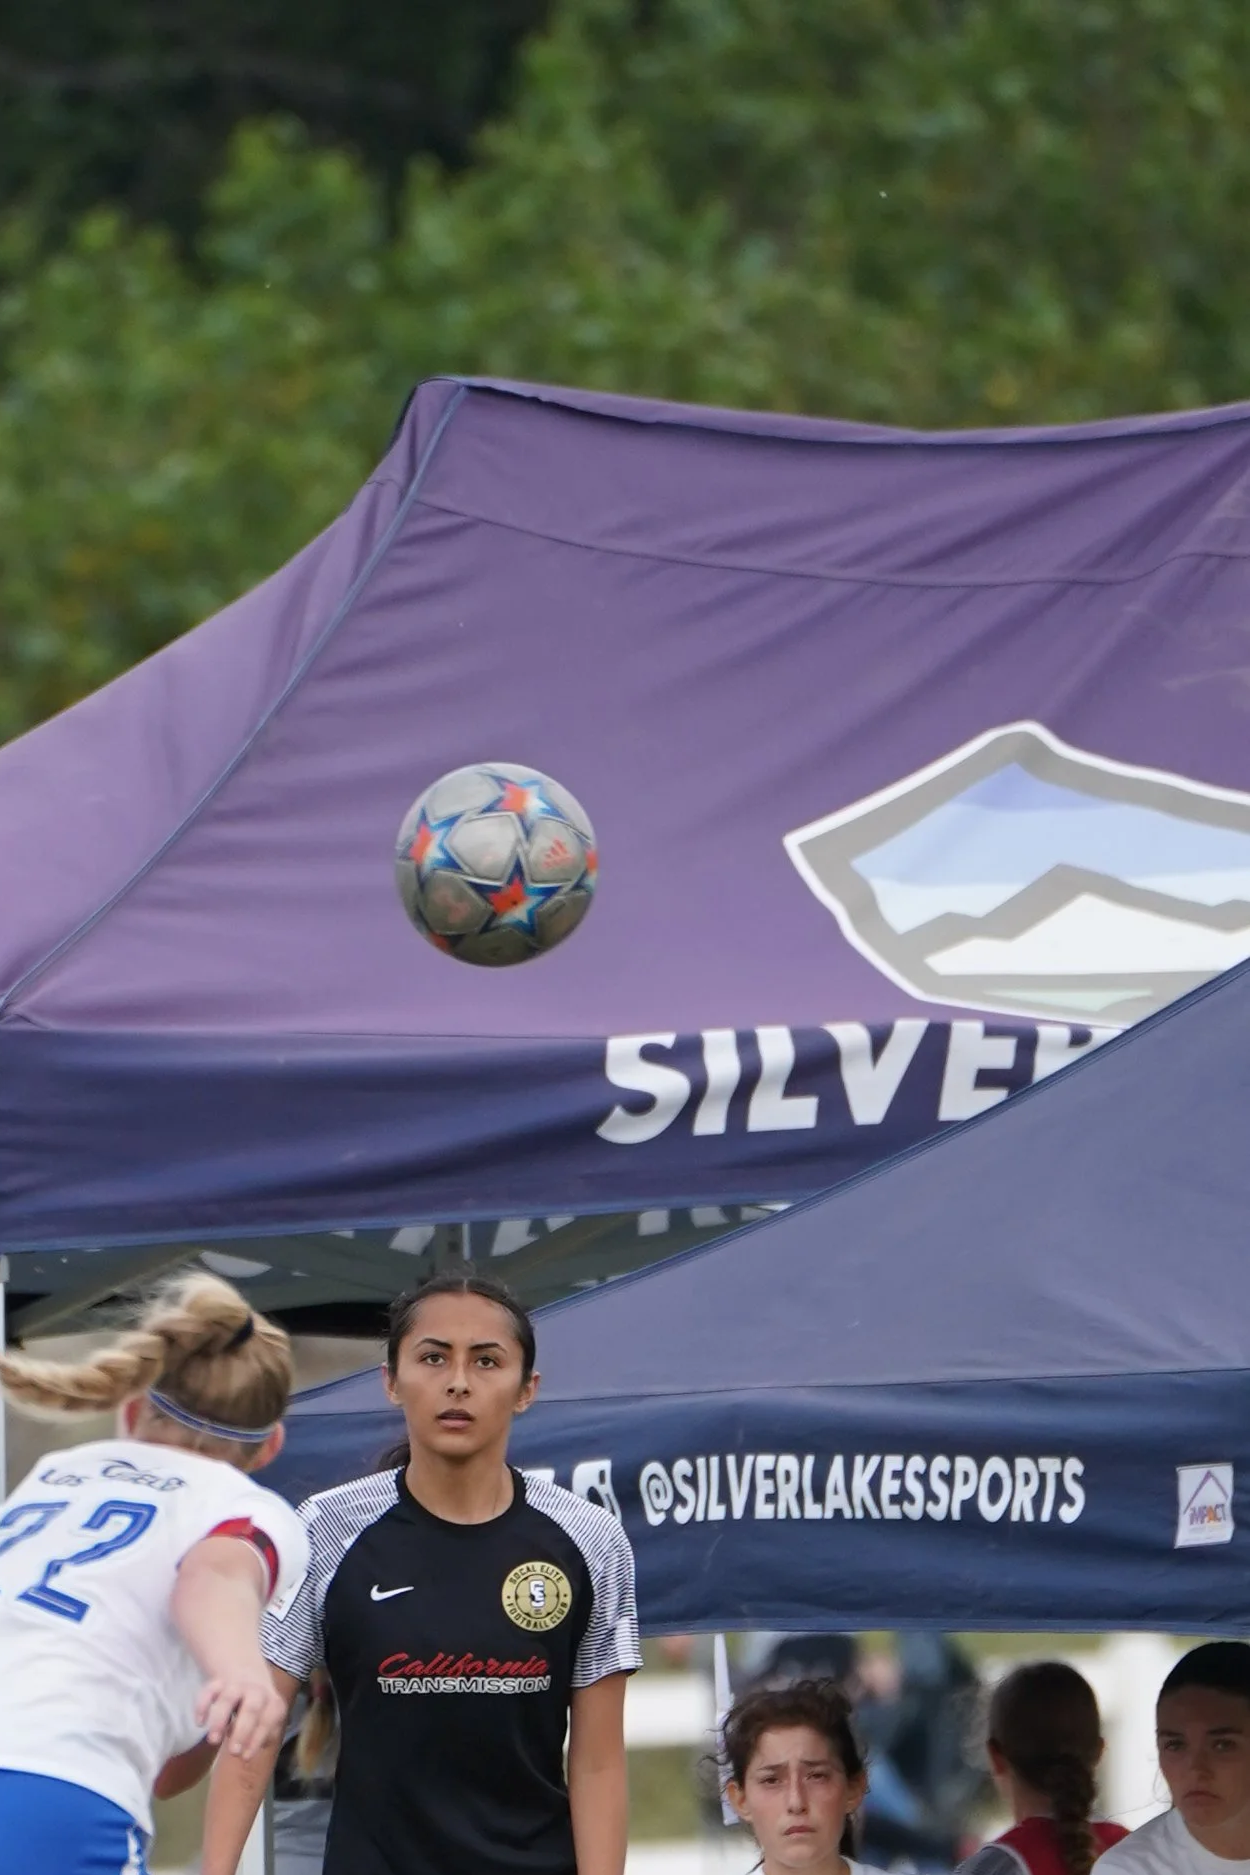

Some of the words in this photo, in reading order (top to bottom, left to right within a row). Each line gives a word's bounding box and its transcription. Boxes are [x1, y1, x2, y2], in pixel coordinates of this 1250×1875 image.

[639, 1453, 1086, 1526] @SILVERLAKESSPORTS
[508, 1564, 537, 1585] SOCAL
[540, 1564, 564, 1583] ELITE
[507, 1602, 549, 1630] FOOTBALL
[549, 1601, 569, 1625] CLUB
[378, 1652, 548, 1678] California
[377, 1674, 551, 1694] TRANSMISSION
